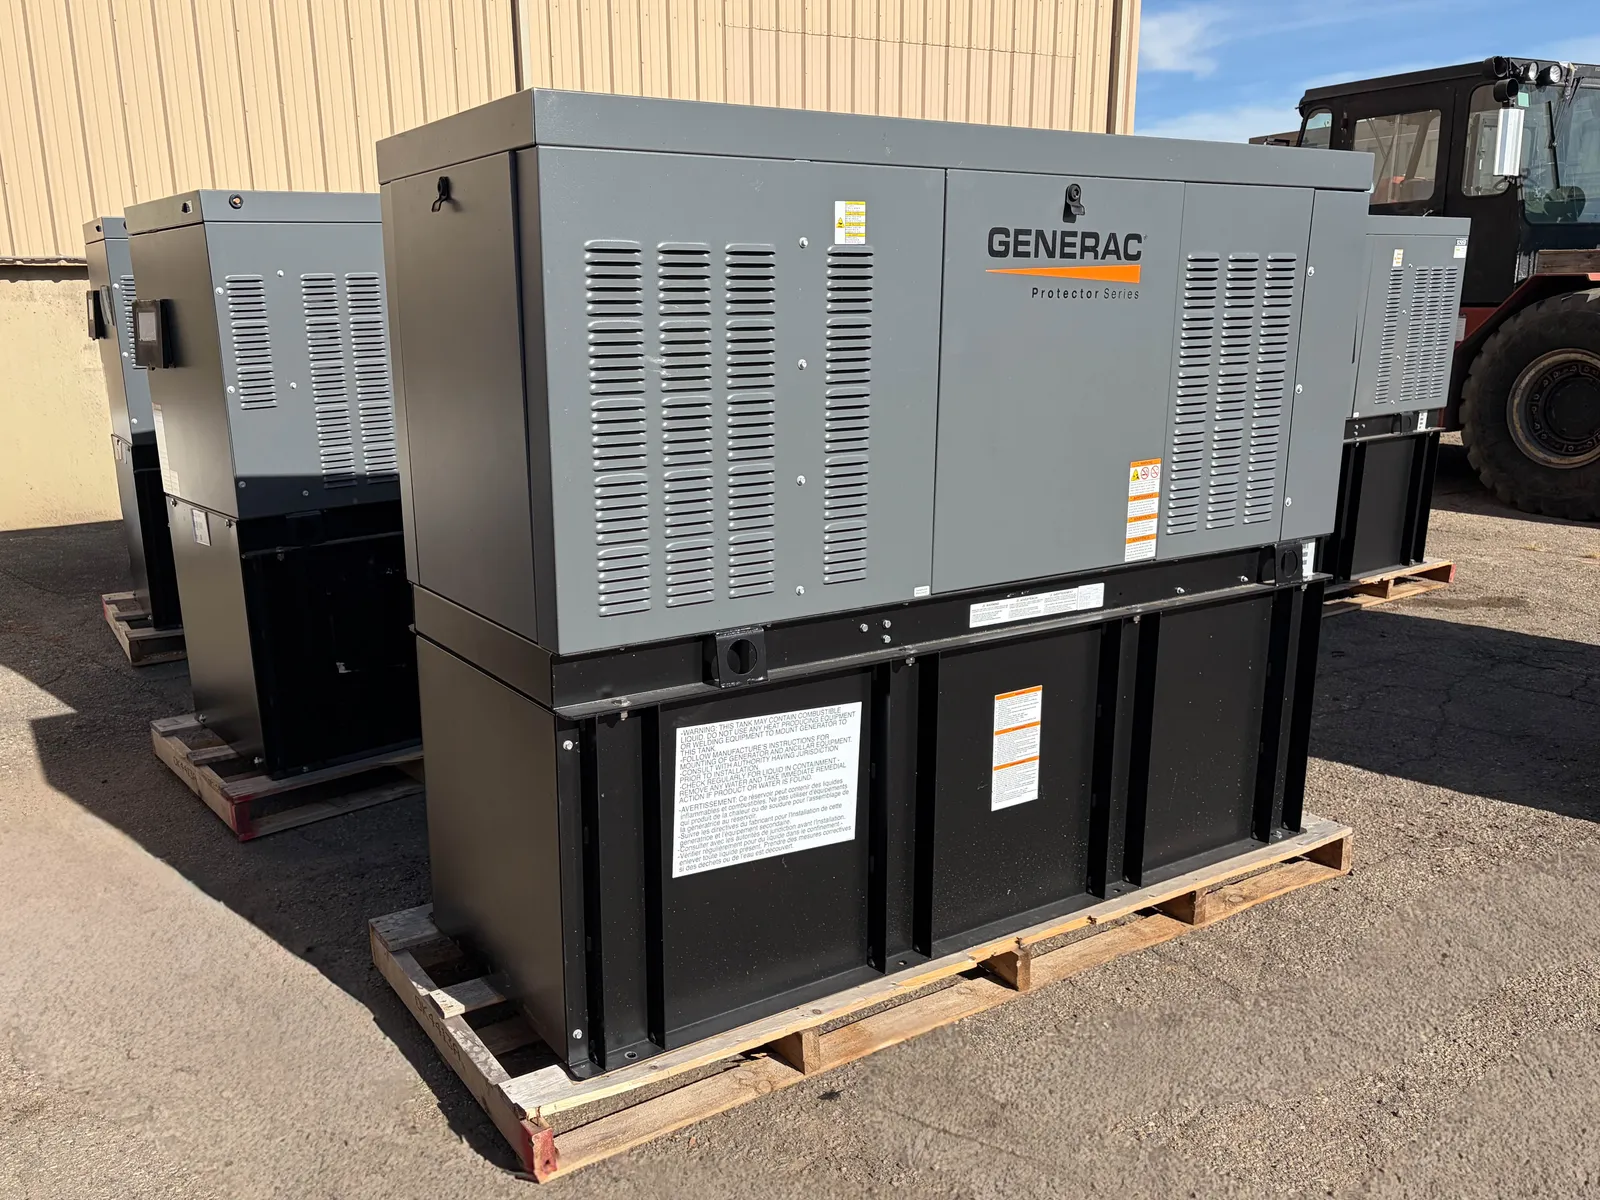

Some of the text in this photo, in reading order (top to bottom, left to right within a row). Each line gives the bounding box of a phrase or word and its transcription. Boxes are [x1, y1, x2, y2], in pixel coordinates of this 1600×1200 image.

[987, 227, 1142, 261] GENERAC
[1031, 287, 1140, 300] Protector Series
[681, 725, 717, 736] -WARNING:
[719, 723, 734, 731] THIS
[736, 720, 752, 728] TANK
[769, 714, 796, 724] CONTAIN
[798, 707, 841, 719] COMBUSTIBLE
[782, 717, 819, 728] PRODUCING
[821, 712, 856, 722] EQUIPMENT
[693, 738, 724, 748] WELDING
[726, 732, 764, 743] EQUIPMENT
[776, 726, 797, 735] MOUNT
[800, 720, 837, 732] GENERATOR
[680, 752, 711, 763] -FOLLOW
[769, 736, 815, 749] INSTRUCTIONS
[680, 758, 716, 770] MOUNTING
[729, 750, 769, 762] GENERATOR
[816, 737, 852, 748] EQUIPMENT.
[680, 766, 713, 777] -CONSULT
[716, 762, 732, 771] WITH
[734, 756, 769, 768] AUTHORITY
[772, 752, 795, 761] HAVING
[680, 780, 705, 790] -CHECK
[707, 773, 745, 785] REGULARLY
[762, 767, 783, 776] LIQUID
[793, 758, 836, 770] CONTAINMENT
[679, 793, 704, 803] ACTION
[714, 786, 745, 797] PRODUCT
[759, 780, 780, 789] WATER
[680, 774, 701, 783] PRIOR
[680, 786, 708, 796] REMOVE
[725, 779, 747, 789] WATER
[782, 768, 814, 779] IMMEDIATE
[816, 762, 846, 773] REMEDIAL
